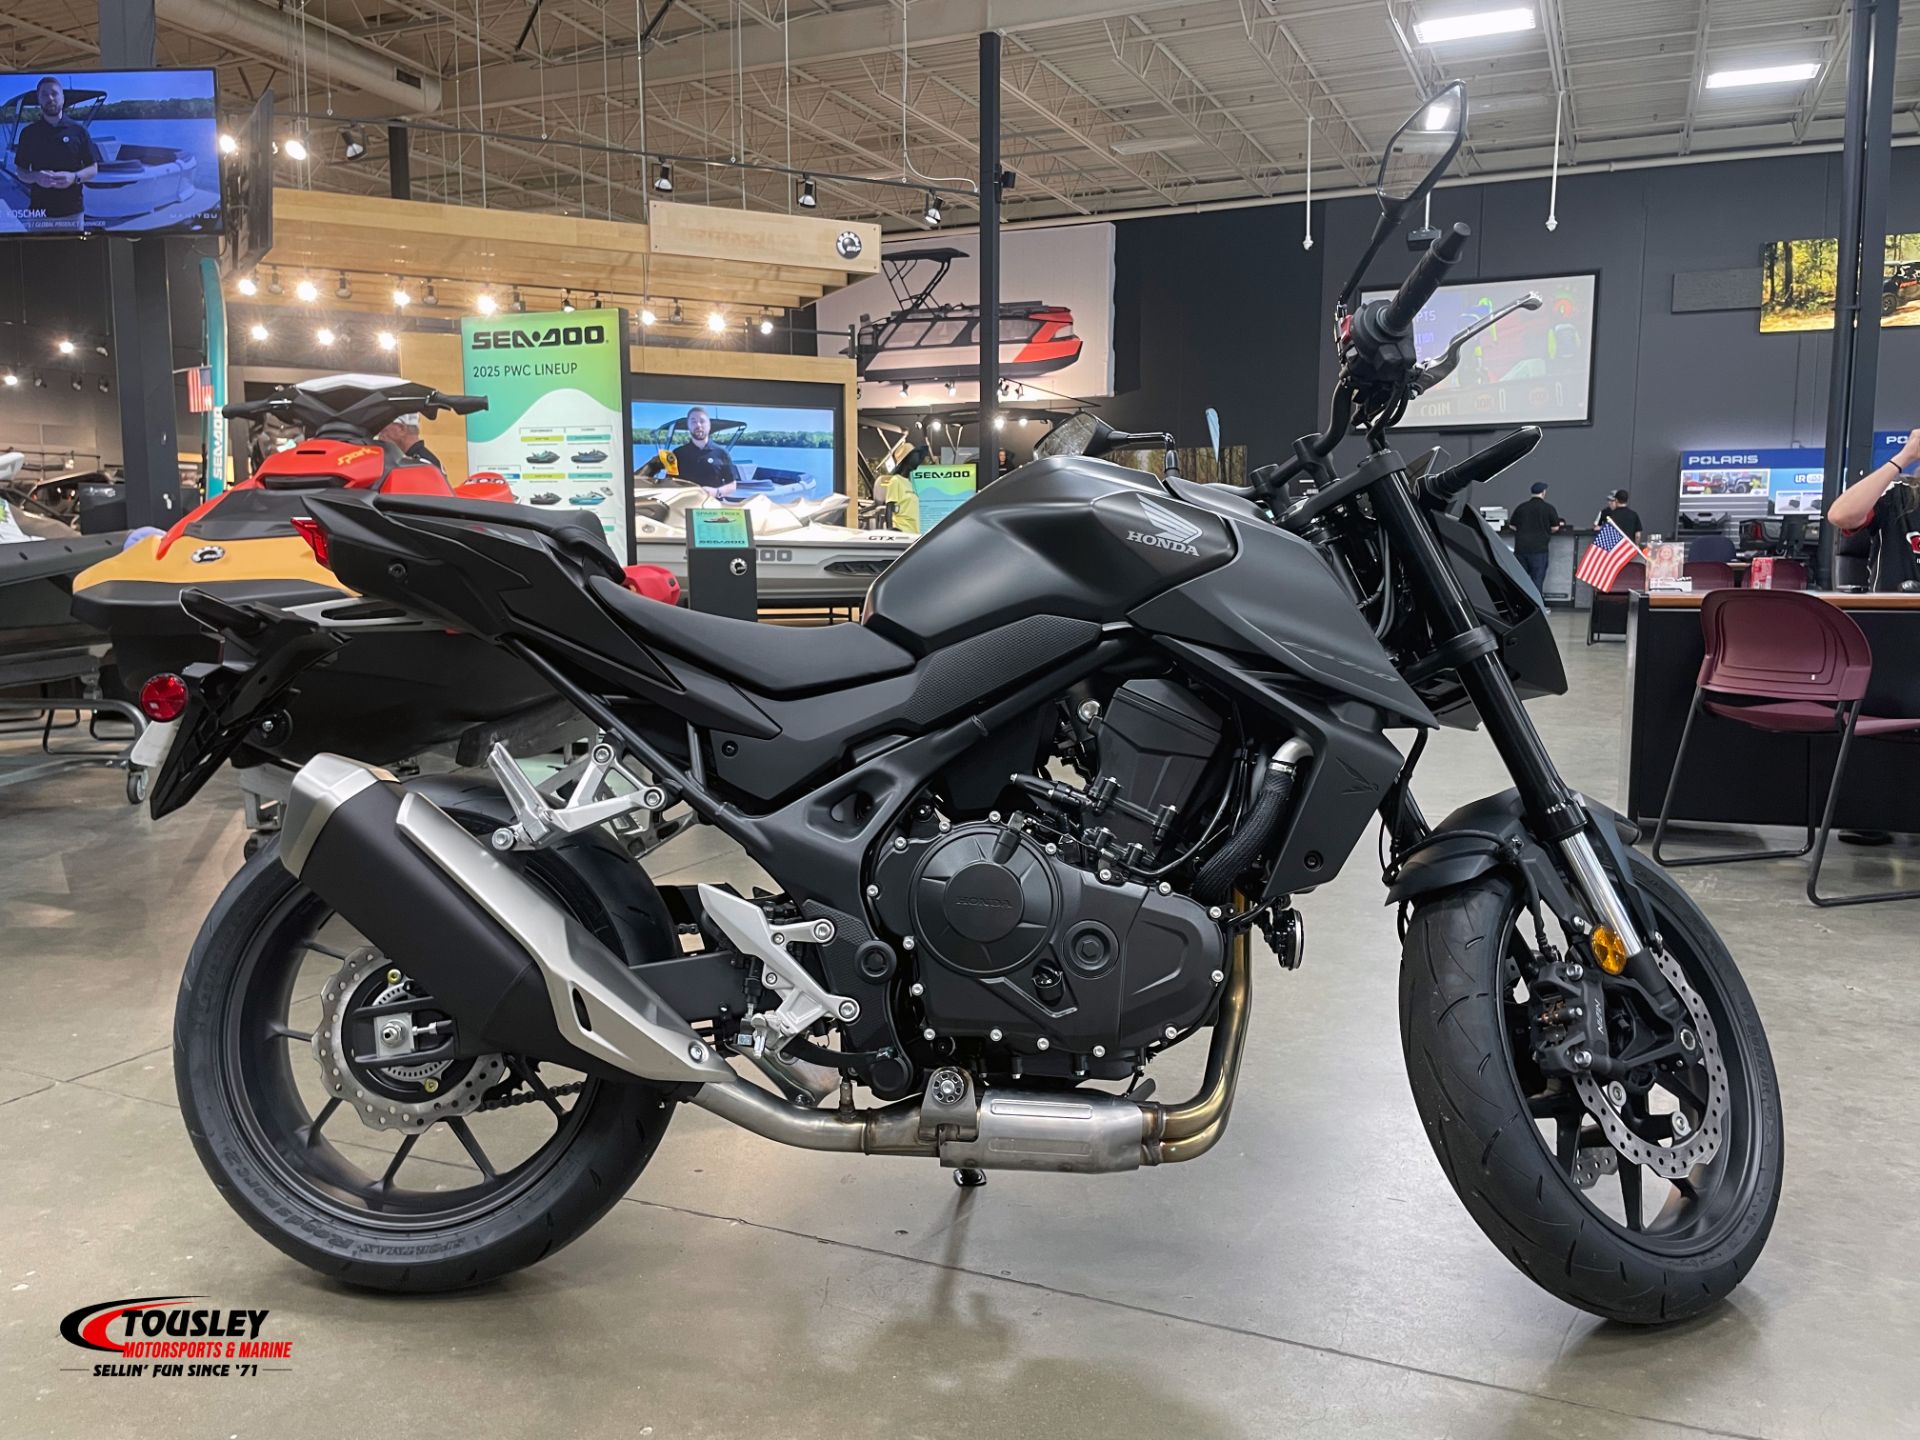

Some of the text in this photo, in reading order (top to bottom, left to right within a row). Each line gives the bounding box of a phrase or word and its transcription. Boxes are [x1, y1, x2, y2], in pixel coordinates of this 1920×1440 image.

[473, 362, 578, 378] 2025 PWC LINEUP
[1886, 435, 1910, 445] PO
[1688, 454, 1759, 465] POLARIS
[1126, 530, 1200, 557] HONDA
[956, 896, 1013, 909] HONDA
